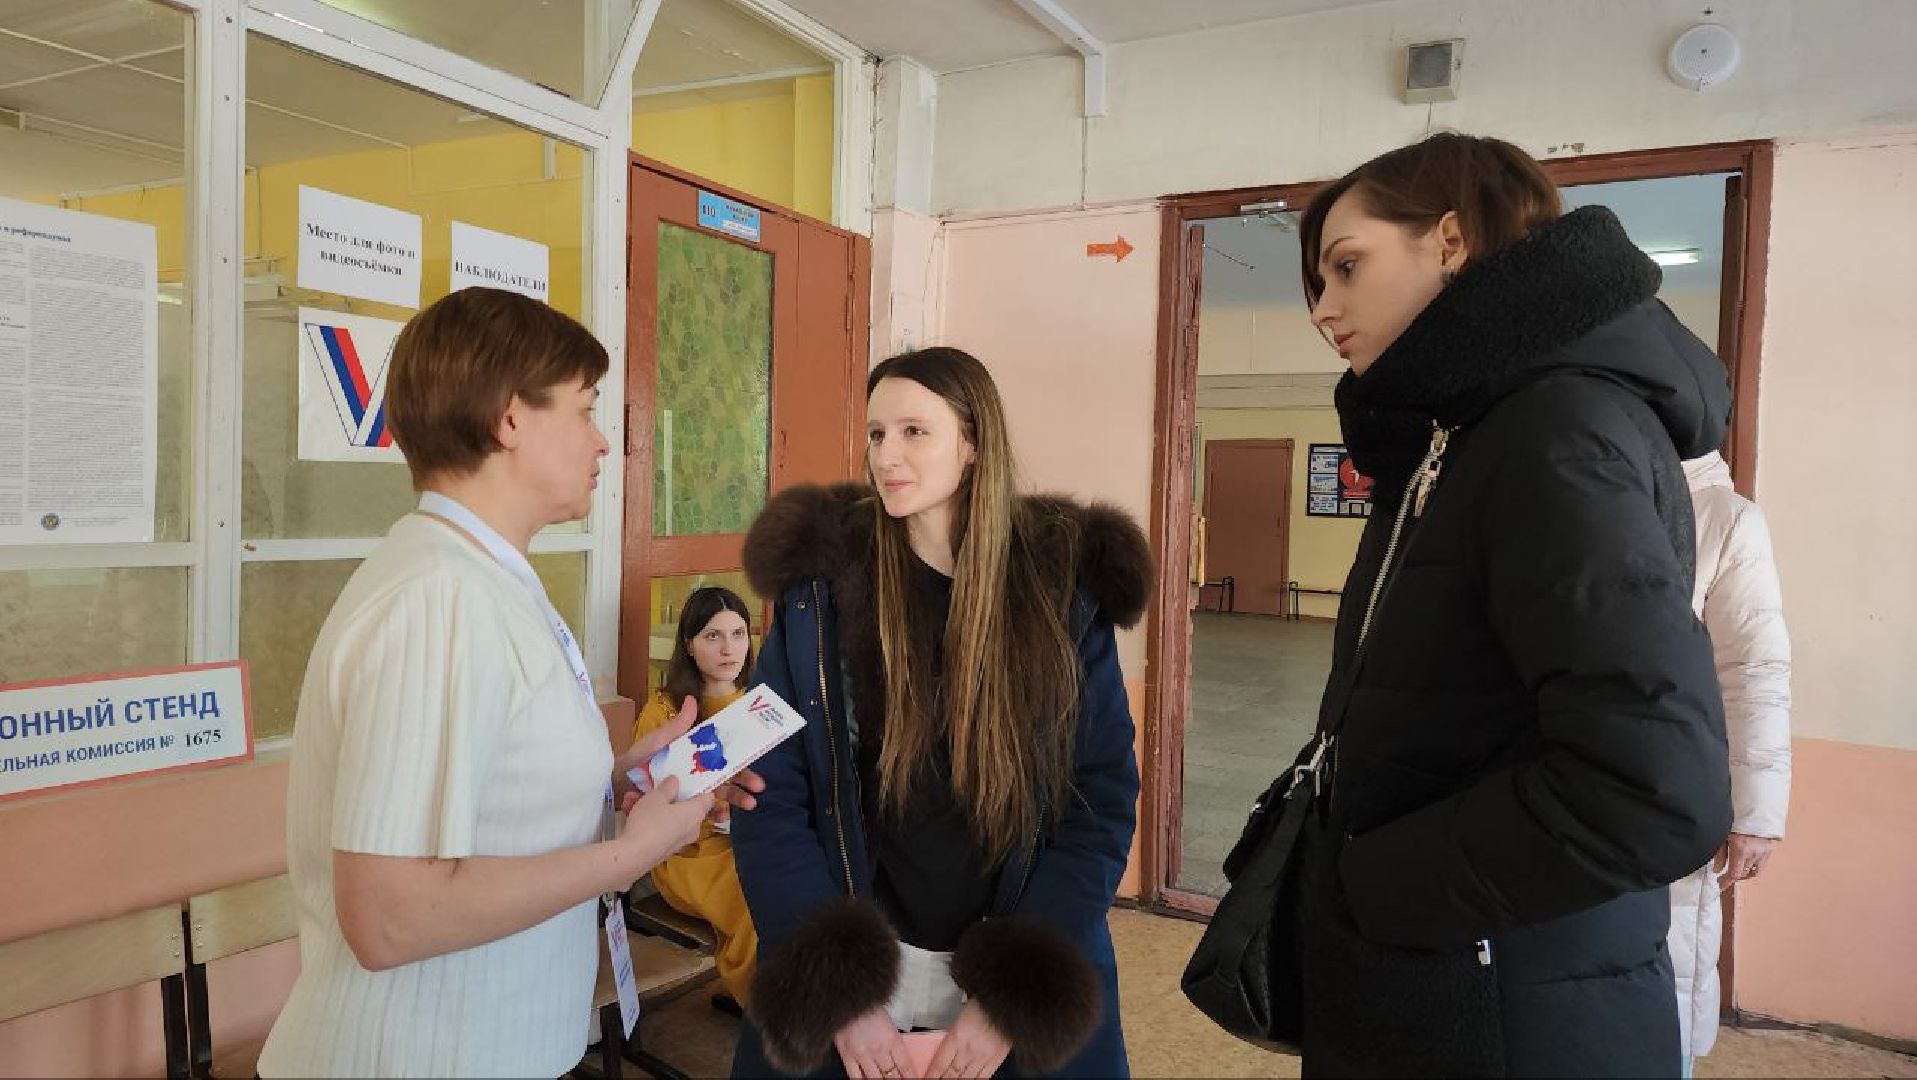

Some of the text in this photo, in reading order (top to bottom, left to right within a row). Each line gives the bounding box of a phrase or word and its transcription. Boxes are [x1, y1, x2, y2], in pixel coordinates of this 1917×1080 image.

[306, 222, 415, 259] Место для фото и
[0, 691, 220, 739] ОННЫЙ СТЕНД
[0, 729, 222, 773] ЛЬНАЯ КОМИССИЯ № 1675
